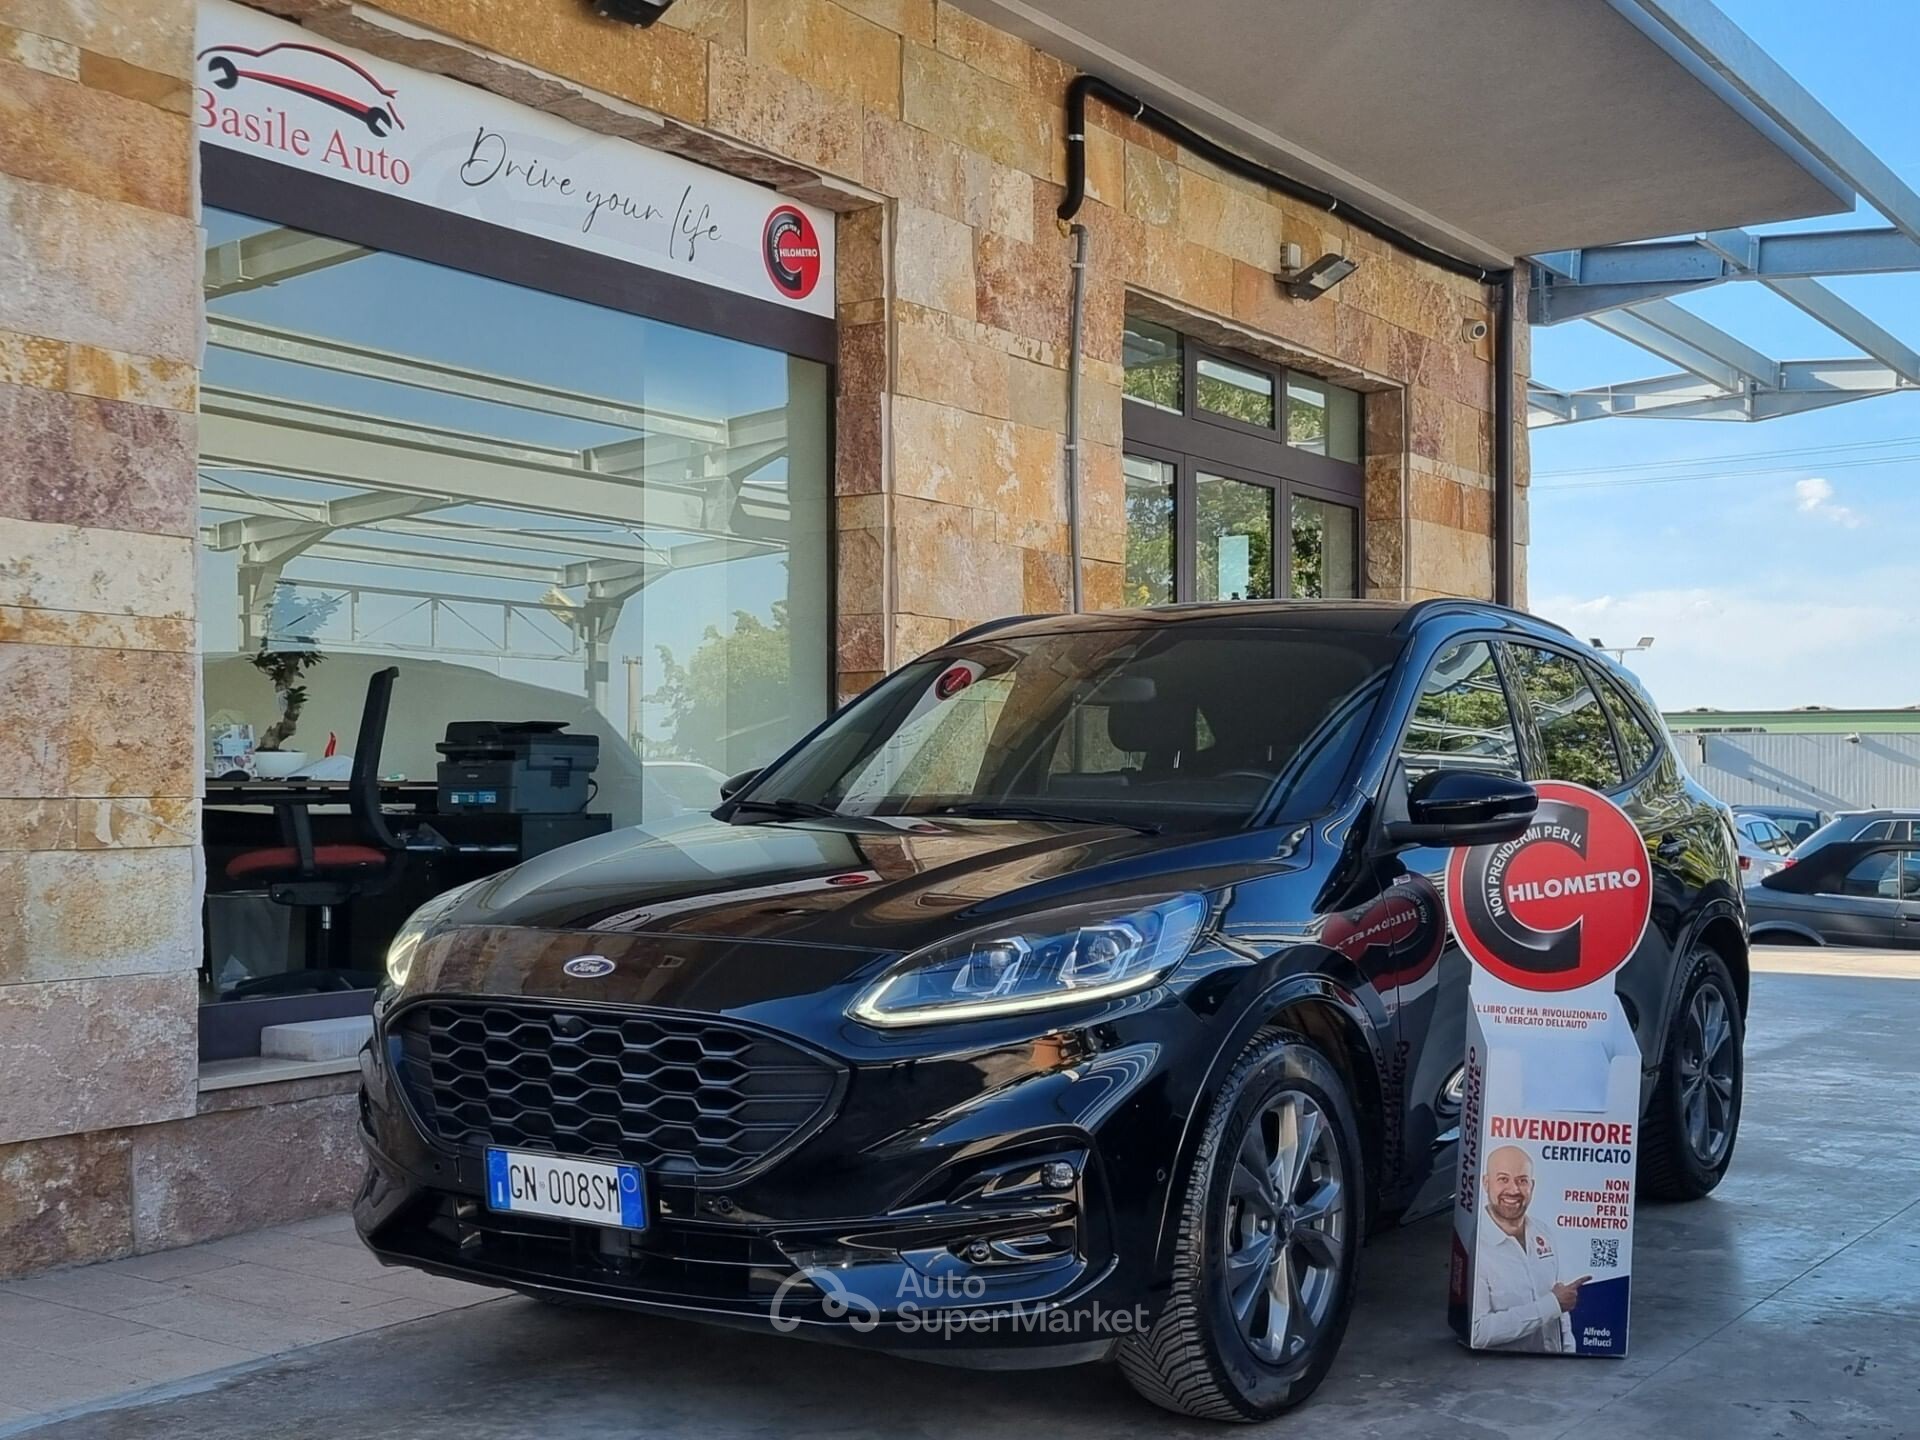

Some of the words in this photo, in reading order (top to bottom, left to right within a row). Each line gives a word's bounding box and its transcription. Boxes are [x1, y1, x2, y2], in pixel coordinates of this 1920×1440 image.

[199, 88, 310, 156] Basile
[320, 129, 411, 185] Auto
[460, 127, 576, 195] Drive
[582, 189, 664, 233] your
[669, 185, 722, 262] life
[1488, 888, 1506, 917] NON
[1544, 825, 1570, 841] PER
[1571, 832, 1582, 848] IL
[1483, 1005, 1507, 1014] LIBRO
[1509, 1006, 1525, 1016] CHE
[1526, 1007, 1538, 1016] HA
[1542, 1007, 1607, 1021] RIVOLUZIONATO
[1494, 1015, 1502, 1024] IL
[1505, 1016, 1544, 1027] MERCATO
[1545, 1018, 1588, 1029] DELL'AUTO
[1464, 1046, 1476, 1144] CONTRO
[1470, 1065, 1482, 1168] INSIEME
[1490, 1116, 1632, 1145] RIVENDITORE
[1541, 1145, 1631, 1164] CERTIFICATO
[510, 1164, 538, 1201] GN
[548, 1169, 621, 1213] 008SM
[1460, 1155, 1470, 1210] NON
[1466, 1174, 1476, 1213] MA
[1564, 1190, 1629, 1204] PRENDERMI
[1605, 1179, 1630, 1191] NON
[1556, 1214, 1628, 1230] CHILOMETRO
[1596, 1204, 1617, 1217] PER
[1619, 1206, 1629, 1217] IL
[1583, 1327, 1611, 1337] Alfredo
